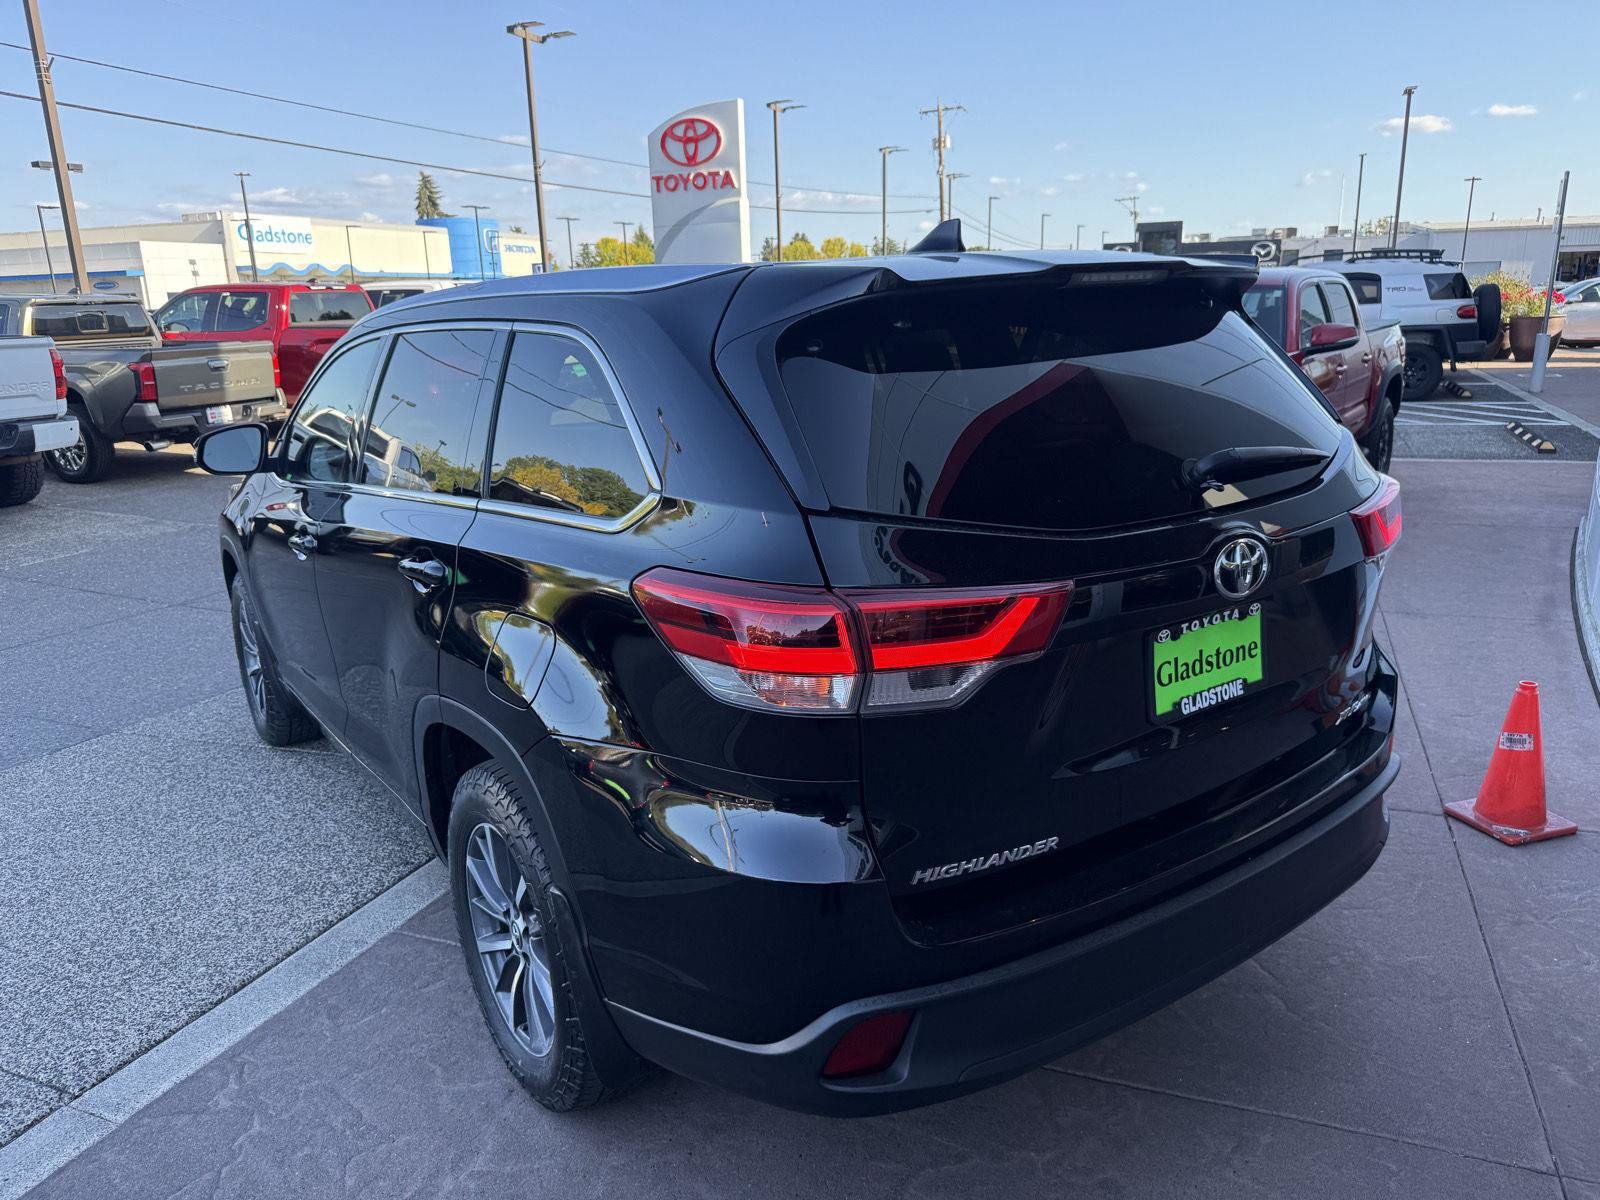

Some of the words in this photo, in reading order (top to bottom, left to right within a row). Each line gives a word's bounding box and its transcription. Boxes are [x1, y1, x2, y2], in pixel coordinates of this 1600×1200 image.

[652, 171, 736, 192] TOYOTA
[1181, 608, 1239, 634] TOYOTA
[1156, 640, 1258, 687] Gladstone
[1181, 678, 1244, 715] GLADSTONE
[911, 836, 1060, 885] HIGHLANDER
